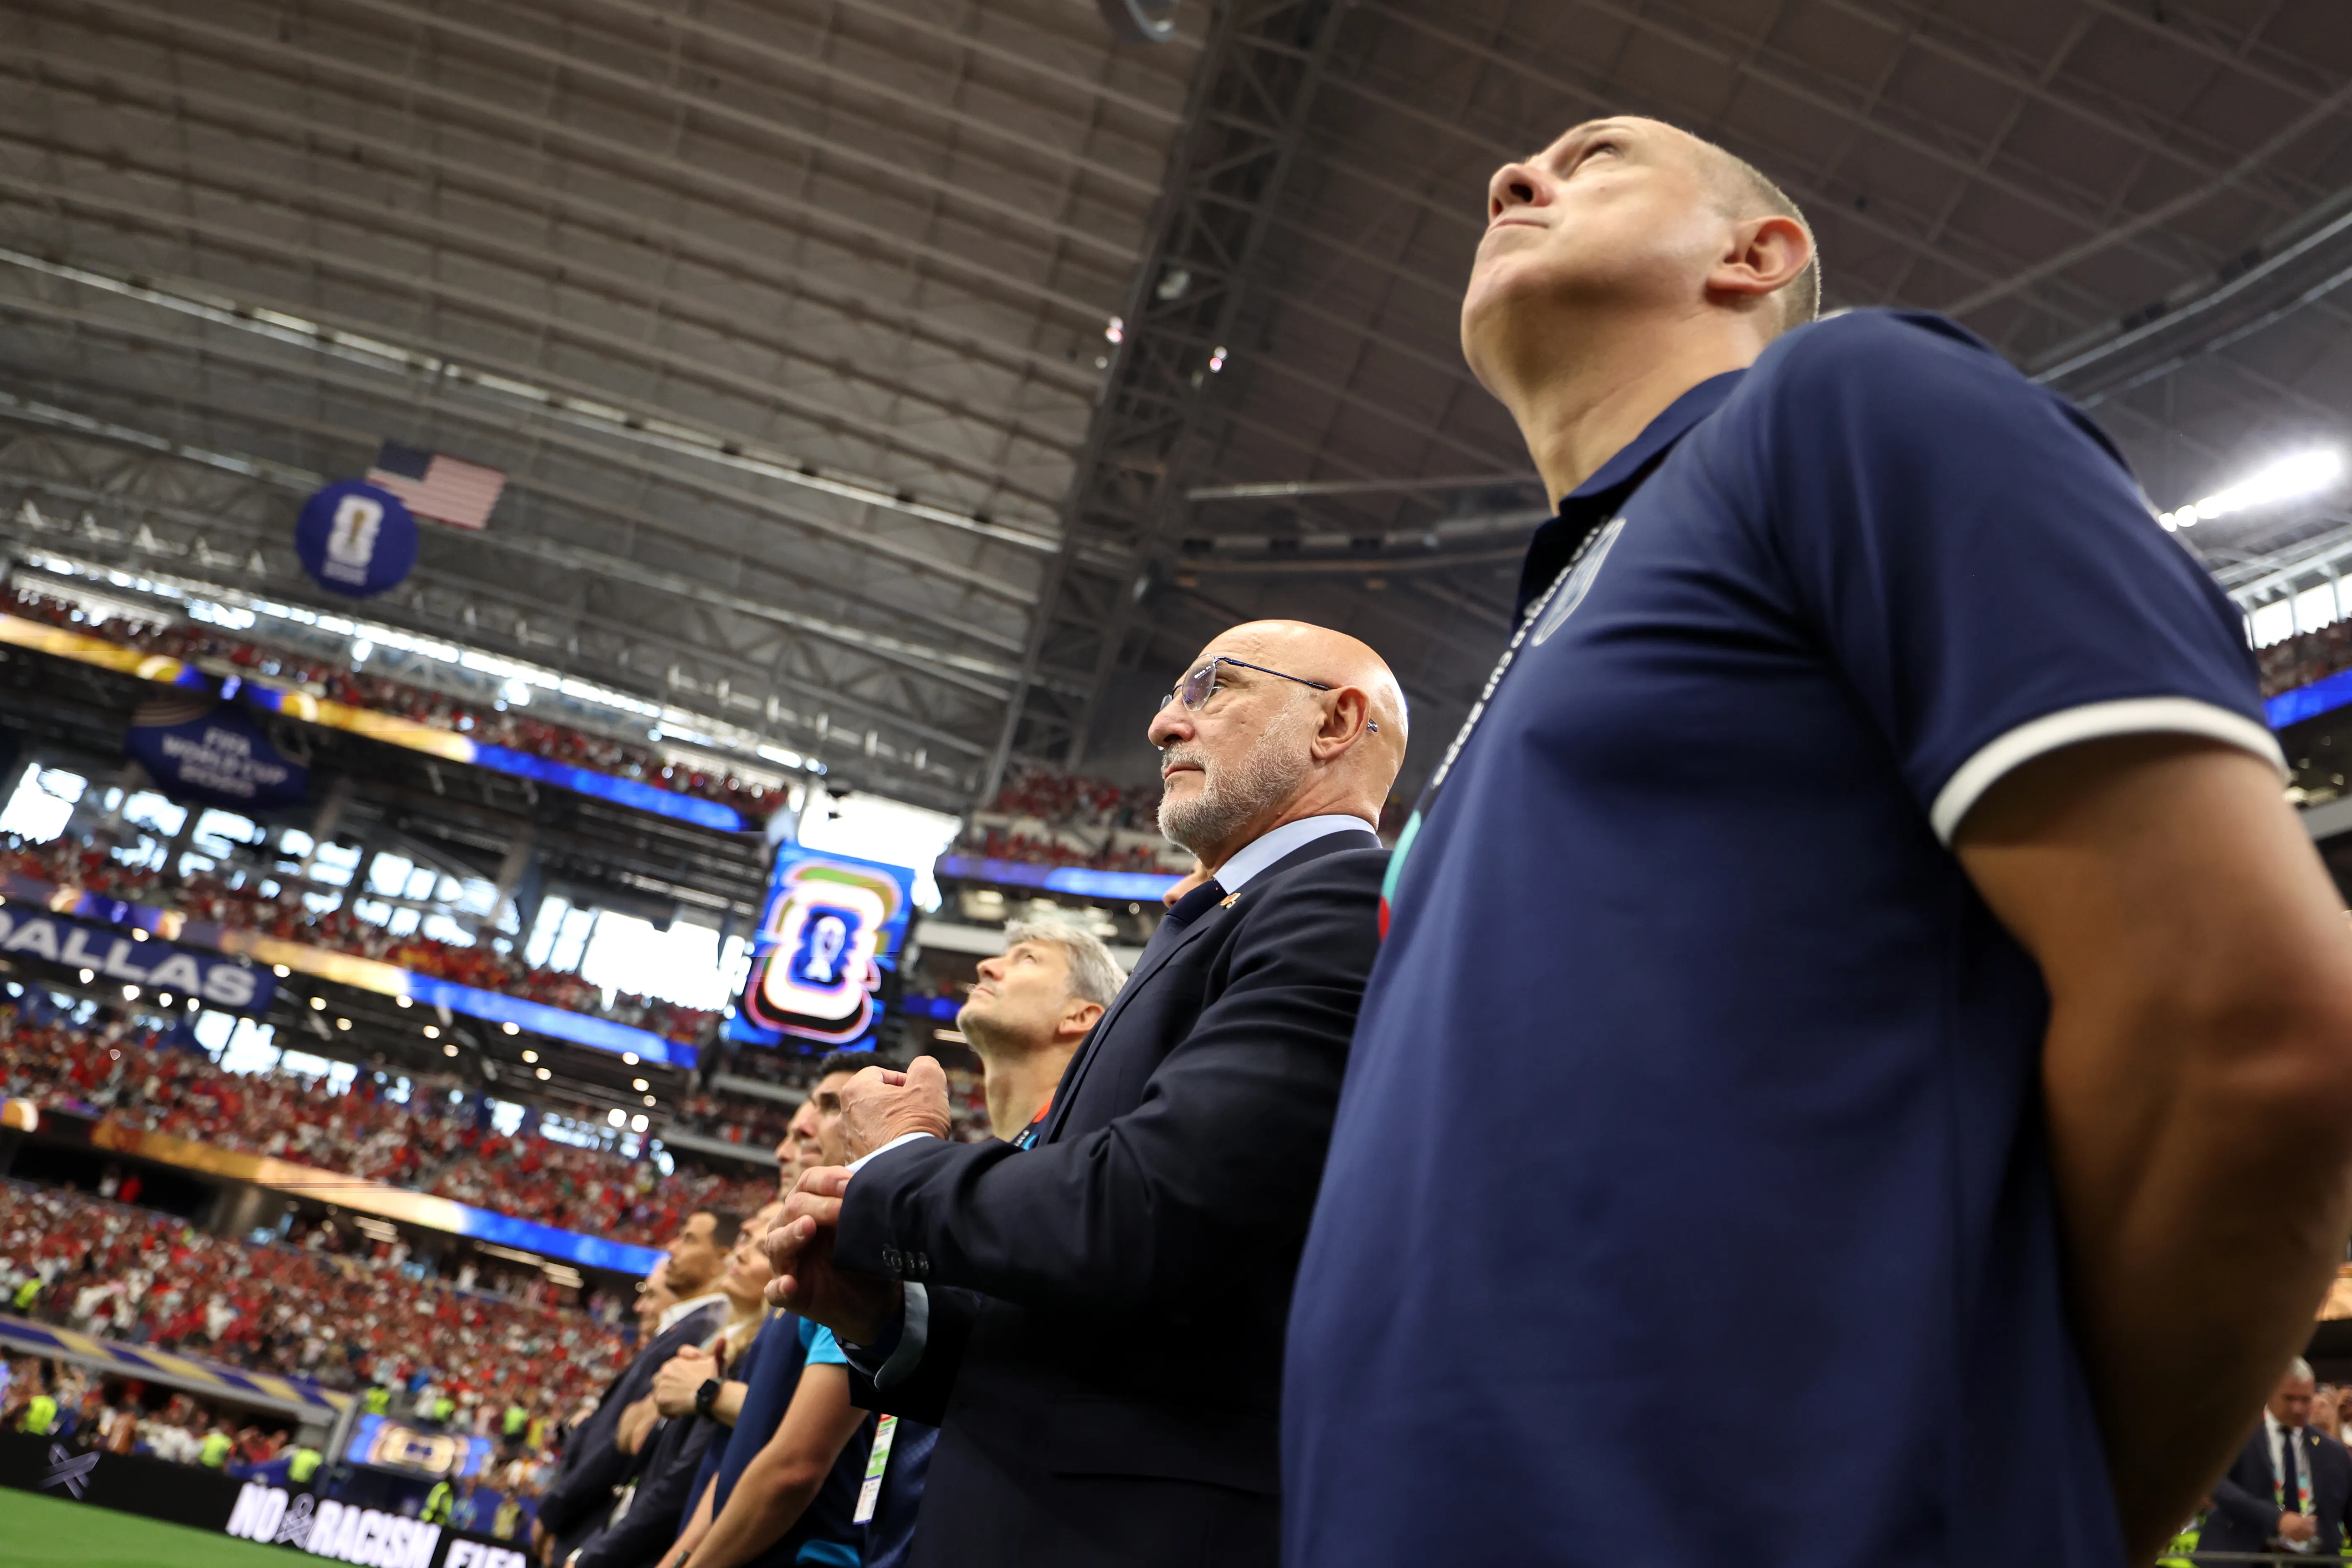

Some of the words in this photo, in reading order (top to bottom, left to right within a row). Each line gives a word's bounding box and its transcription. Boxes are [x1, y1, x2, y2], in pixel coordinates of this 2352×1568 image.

[1510, 565, 1573, 649] WORLD
[1482, 651, 1513, 701] CUP
[225, 1482, 289, 1543] NO
[306, 1499, 442, 1568] RACISM
